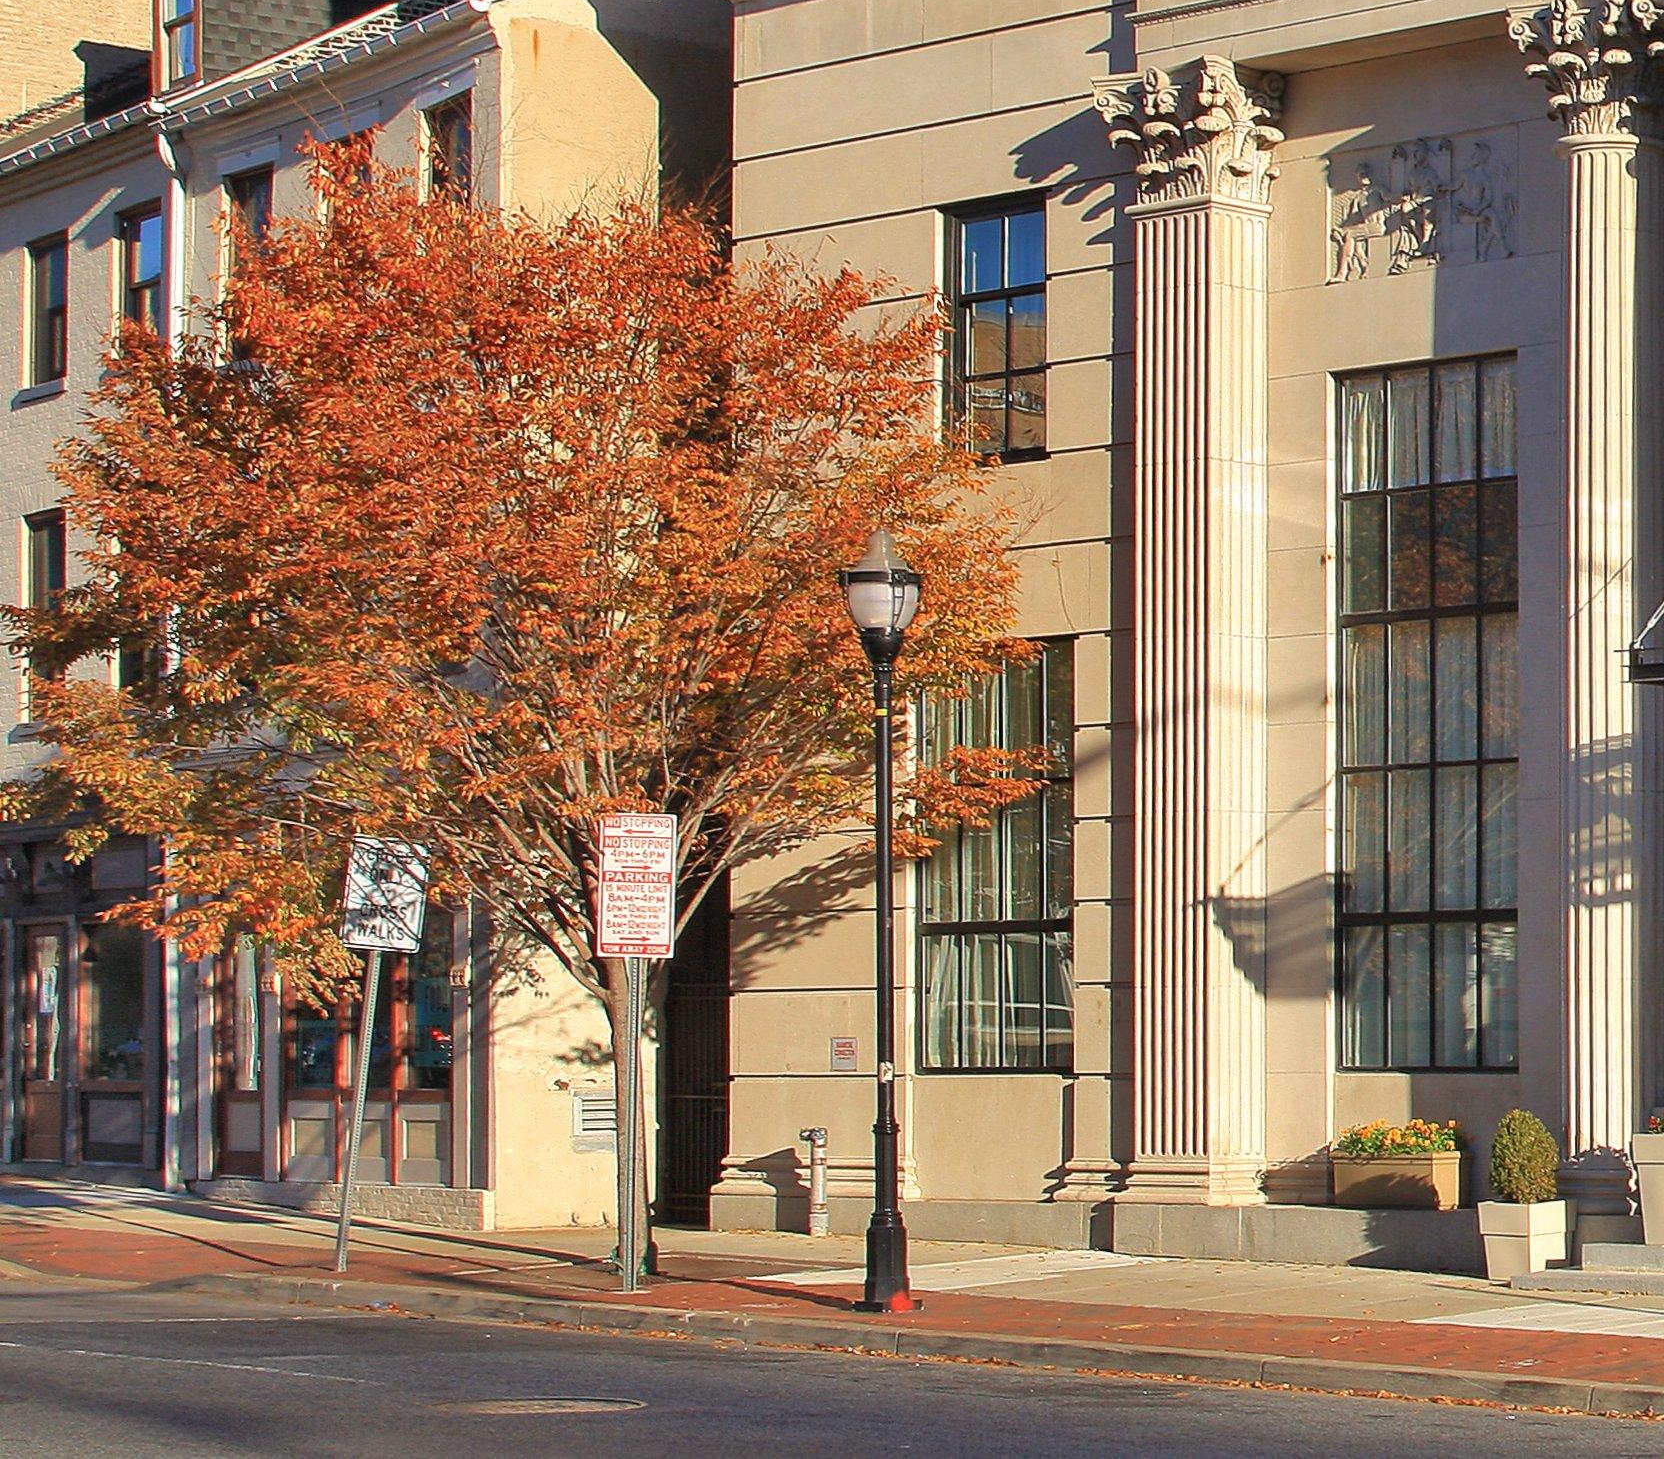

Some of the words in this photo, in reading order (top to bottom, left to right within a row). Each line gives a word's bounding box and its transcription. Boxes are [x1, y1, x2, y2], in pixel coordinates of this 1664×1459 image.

[622, 818, 671, 829] STOPPING
[605, 838, 620, 847] NO
[622, 838, 670, 849] STOPPING
[605, 872, 670, 883] PARKING
[358, 922, 405, 941] WALKS
